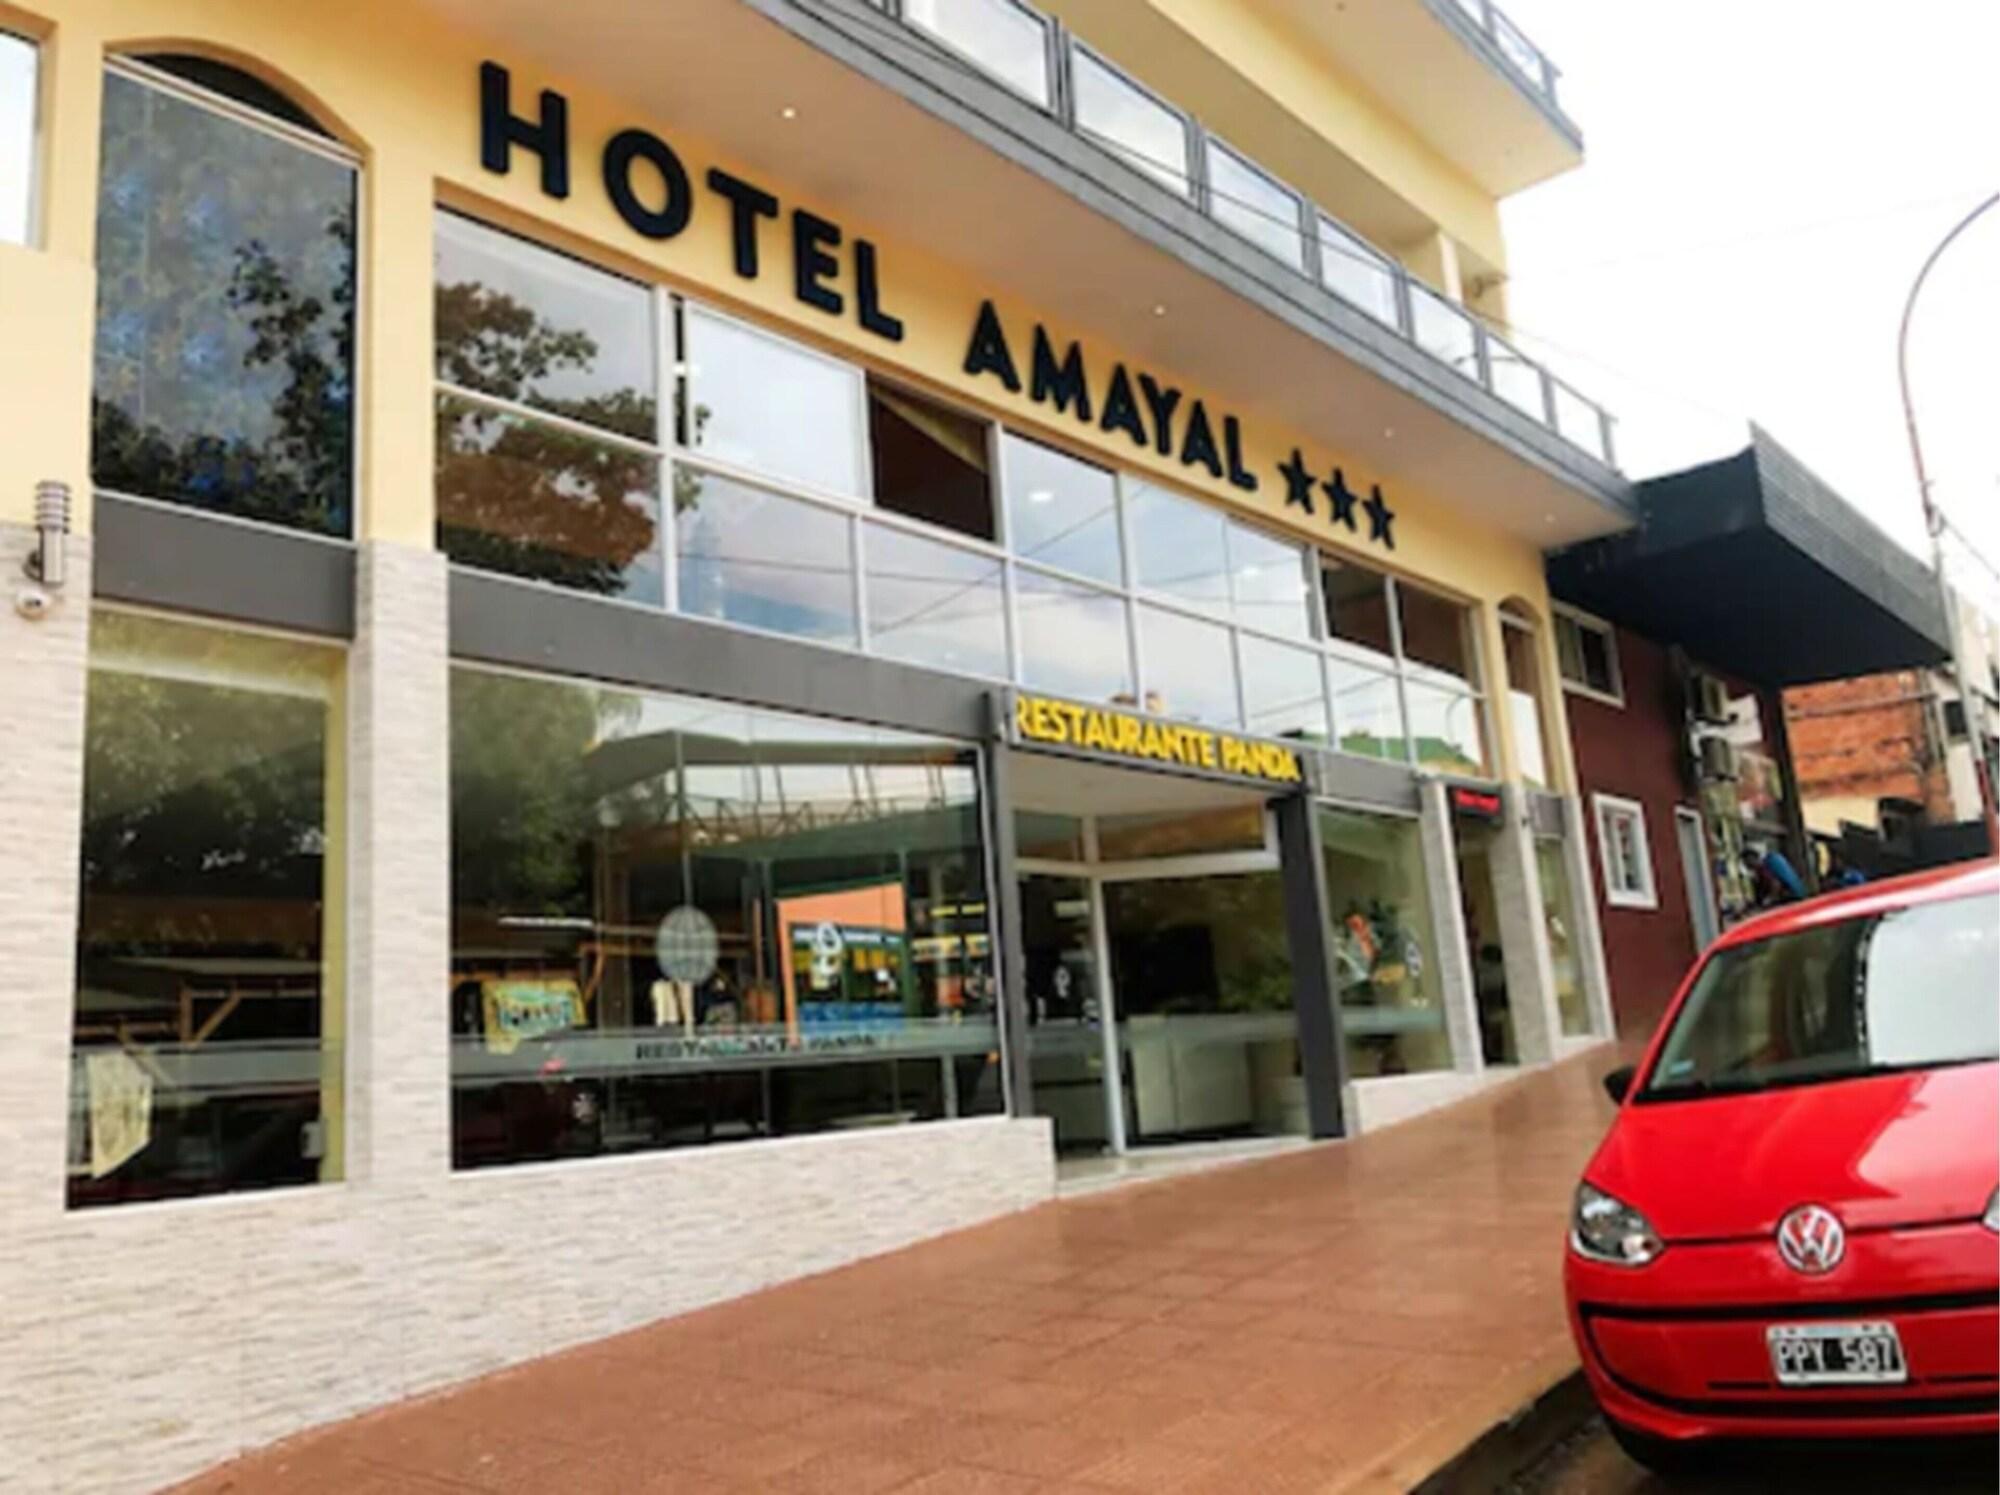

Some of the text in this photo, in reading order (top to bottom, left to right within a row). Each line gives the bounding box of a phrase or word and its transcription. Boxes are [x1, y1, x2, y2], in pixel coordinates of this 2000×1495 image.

[480, 60, 1257, 491] HOTEL AMAYAL
[1016, 694, 1301, 781] RESTAURANTE PANDA
[1777, 1336, 1893, 1372] PPY 587
